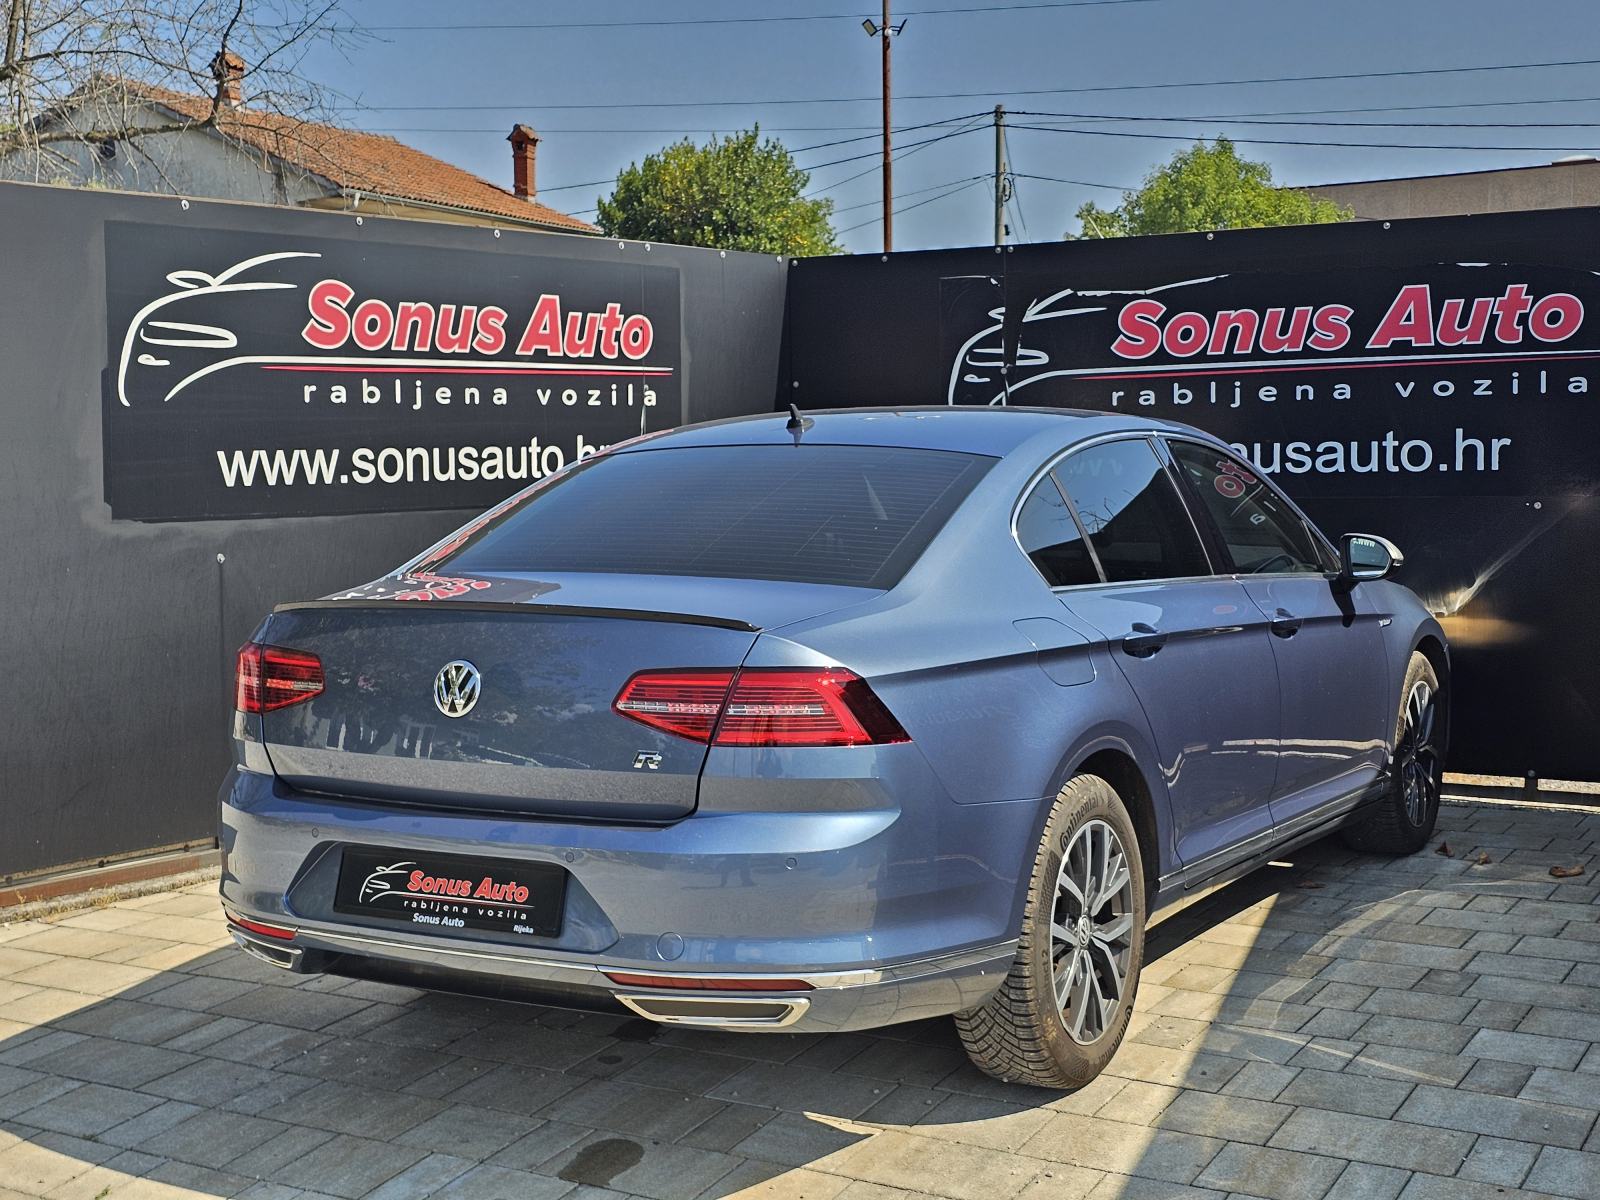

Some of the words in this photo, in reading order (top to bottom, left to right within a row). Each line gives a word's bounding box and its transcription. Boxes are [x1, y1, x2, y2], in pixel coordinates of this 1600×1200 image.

[302, 279, 508, 355] Sonus
[515, 293, 654, 360] Auto
[1111, 299, 1355, 360] Sonus
[1365, 284, 1584, 350] Auto
[303, 378, 508, 410] rabljena
[536, 383, 658, 407] vozila
[1111, 382, 1352, 408] rabljena
[1395, 370, 1588, 399] vozila
[407, 870, 472, 898] Sonus
[473, 877, 529, 903] Auto
[404, 900, 469, 914] rabljena
[478, 908, 527, 920] vozila
[412, 912, 441, 926] Sonus
[441, 916, 465, 928] Auto
[513, 924, 534, 935] Rijeka
